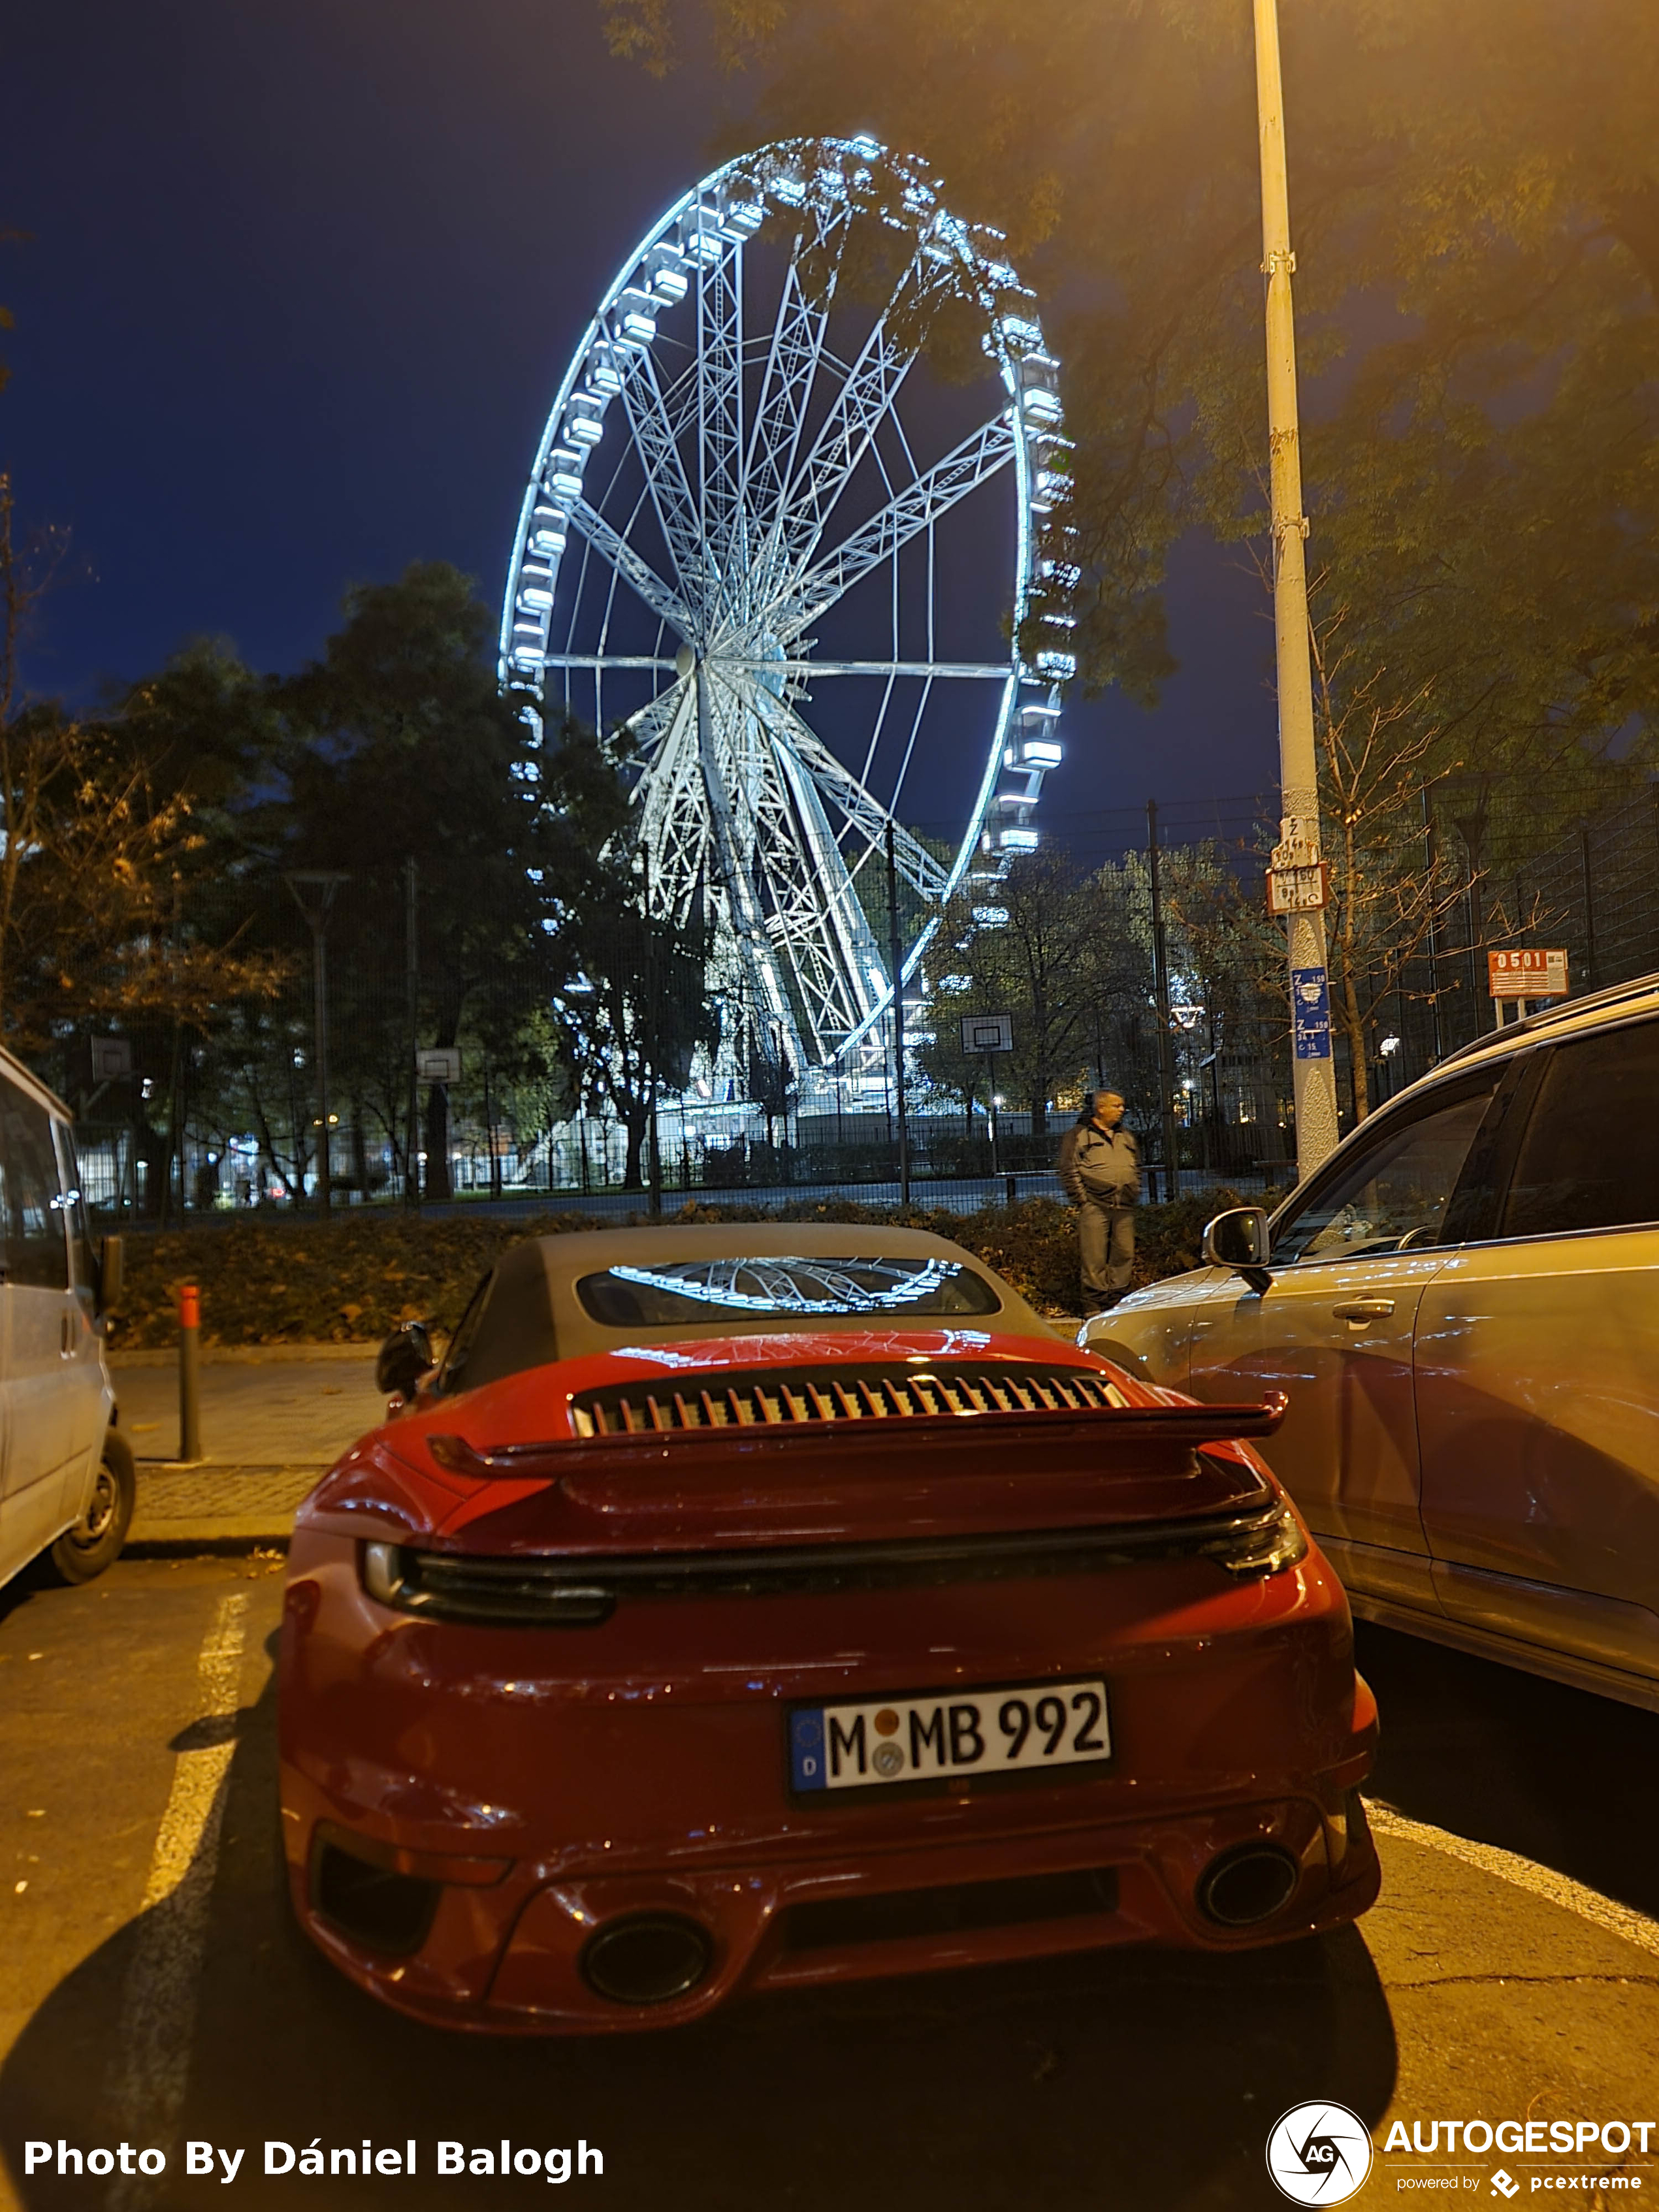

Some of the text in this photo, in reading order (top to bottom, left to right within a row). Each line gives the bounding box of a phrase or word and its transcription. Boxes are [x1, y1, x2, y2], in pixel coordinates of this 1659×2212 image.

[1498, 952, 1540, 968] 0501
[1293, 974, 1325, 986] Z 150
[1297, 1019, 1305, 1030] Z
[830, 1691, 1104, 1778] M MB 992
[803, 1755, 816, 1776] D
